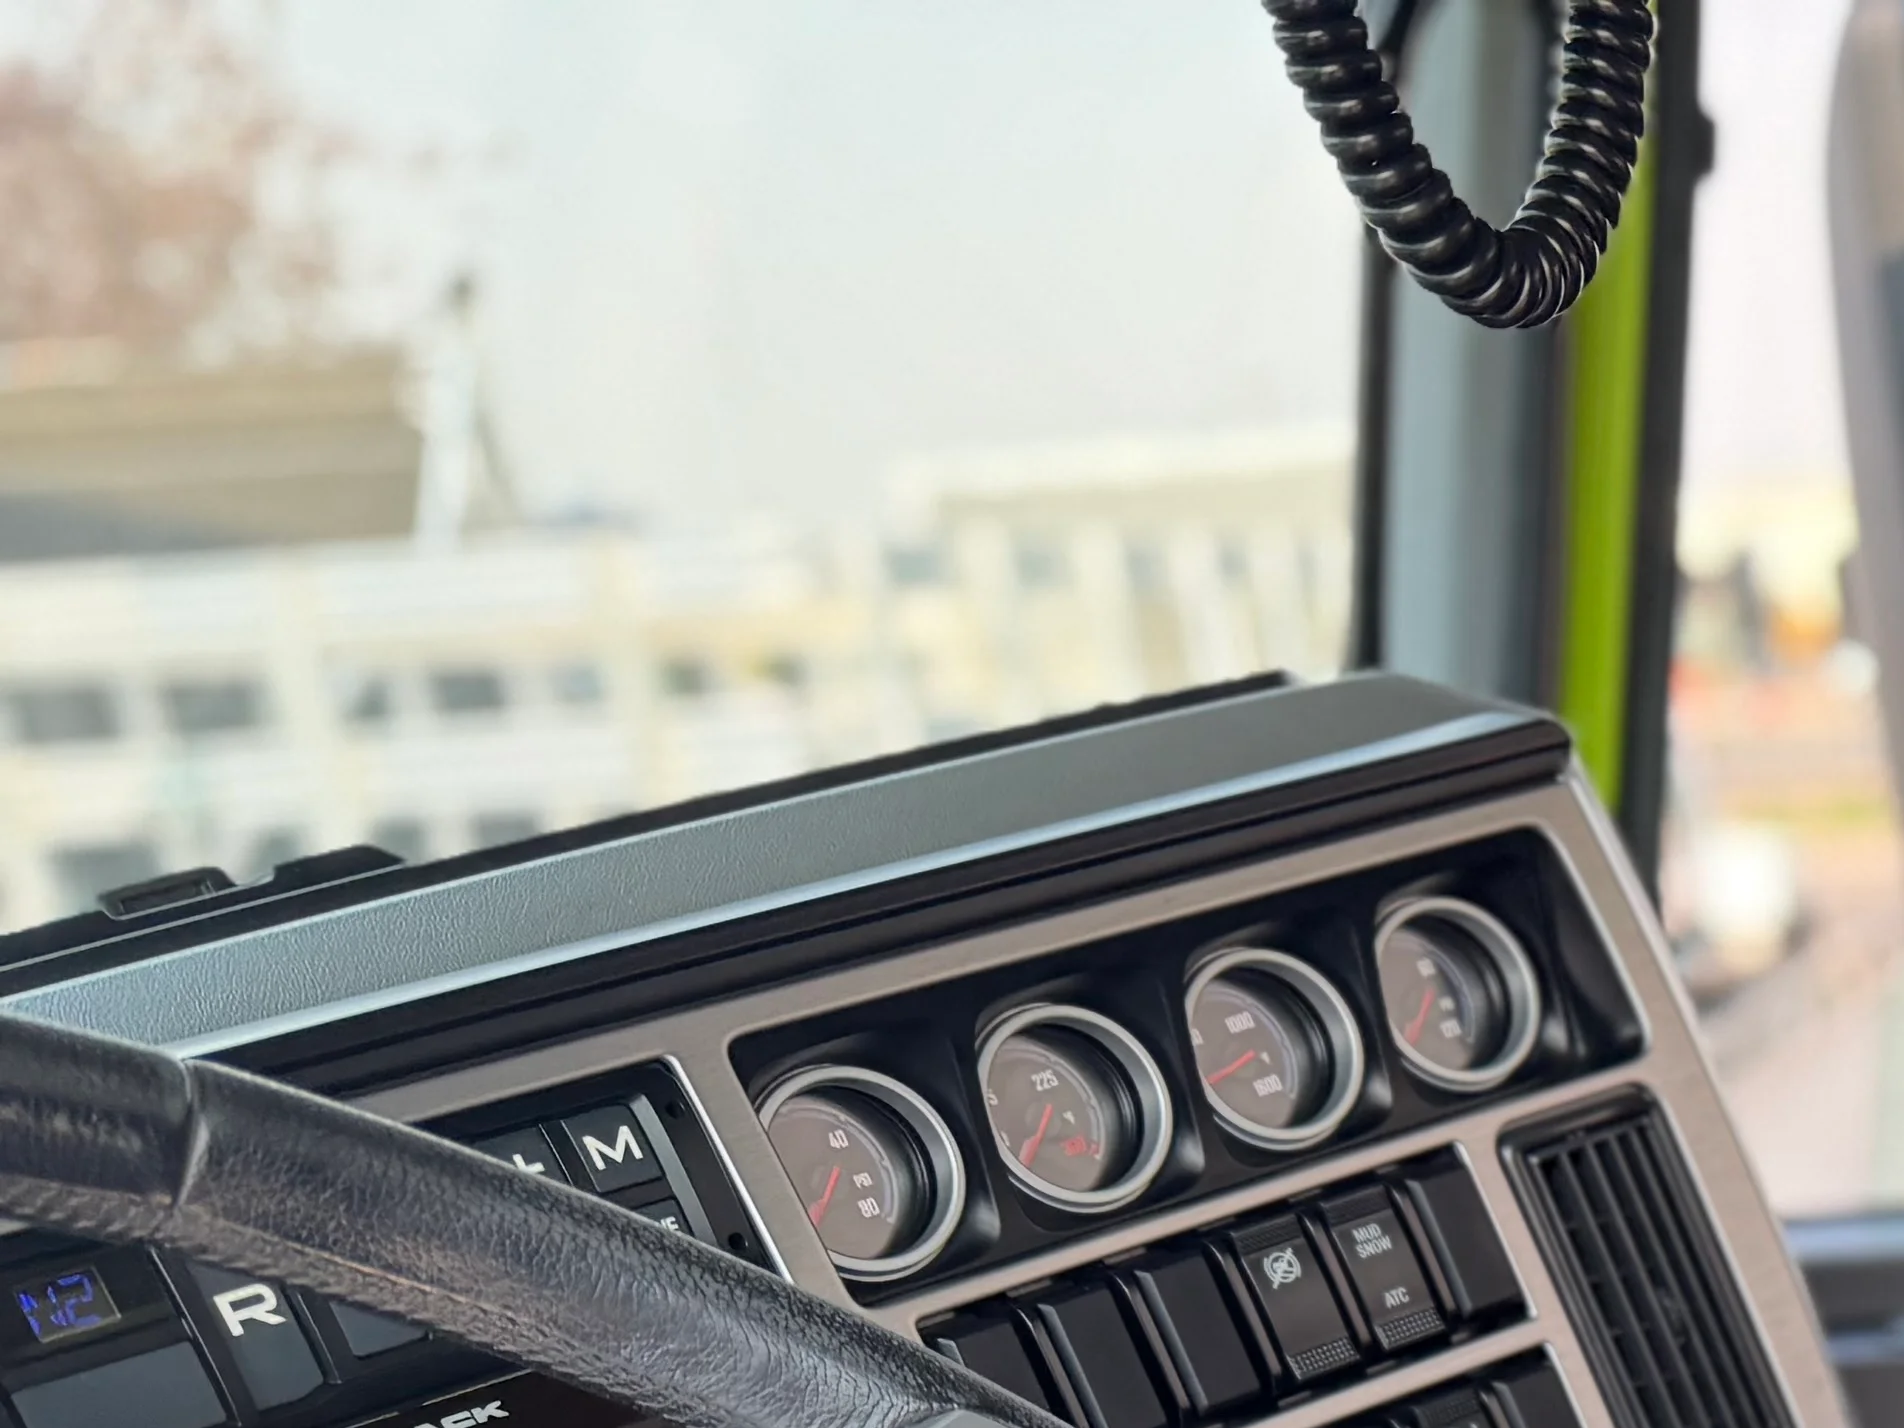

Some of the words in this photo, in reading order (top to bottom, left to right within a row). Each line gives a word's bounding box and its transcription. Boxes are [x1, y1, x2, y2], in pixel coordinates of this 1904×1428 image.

[1224, 1011, 1256, 1034] 1000
[1031, 1069, 1059, 1091] 225
[582, 1125, 643, 1171] M
[828, 1129, 848, 1149] 40
[1352, 1223, 1381, 1242] MUD
[1356, 1235, 1392, 1258] SNOW
[1384, 1287, 1409, 1309] ATC
[213, 1283, 287, 1337] R
